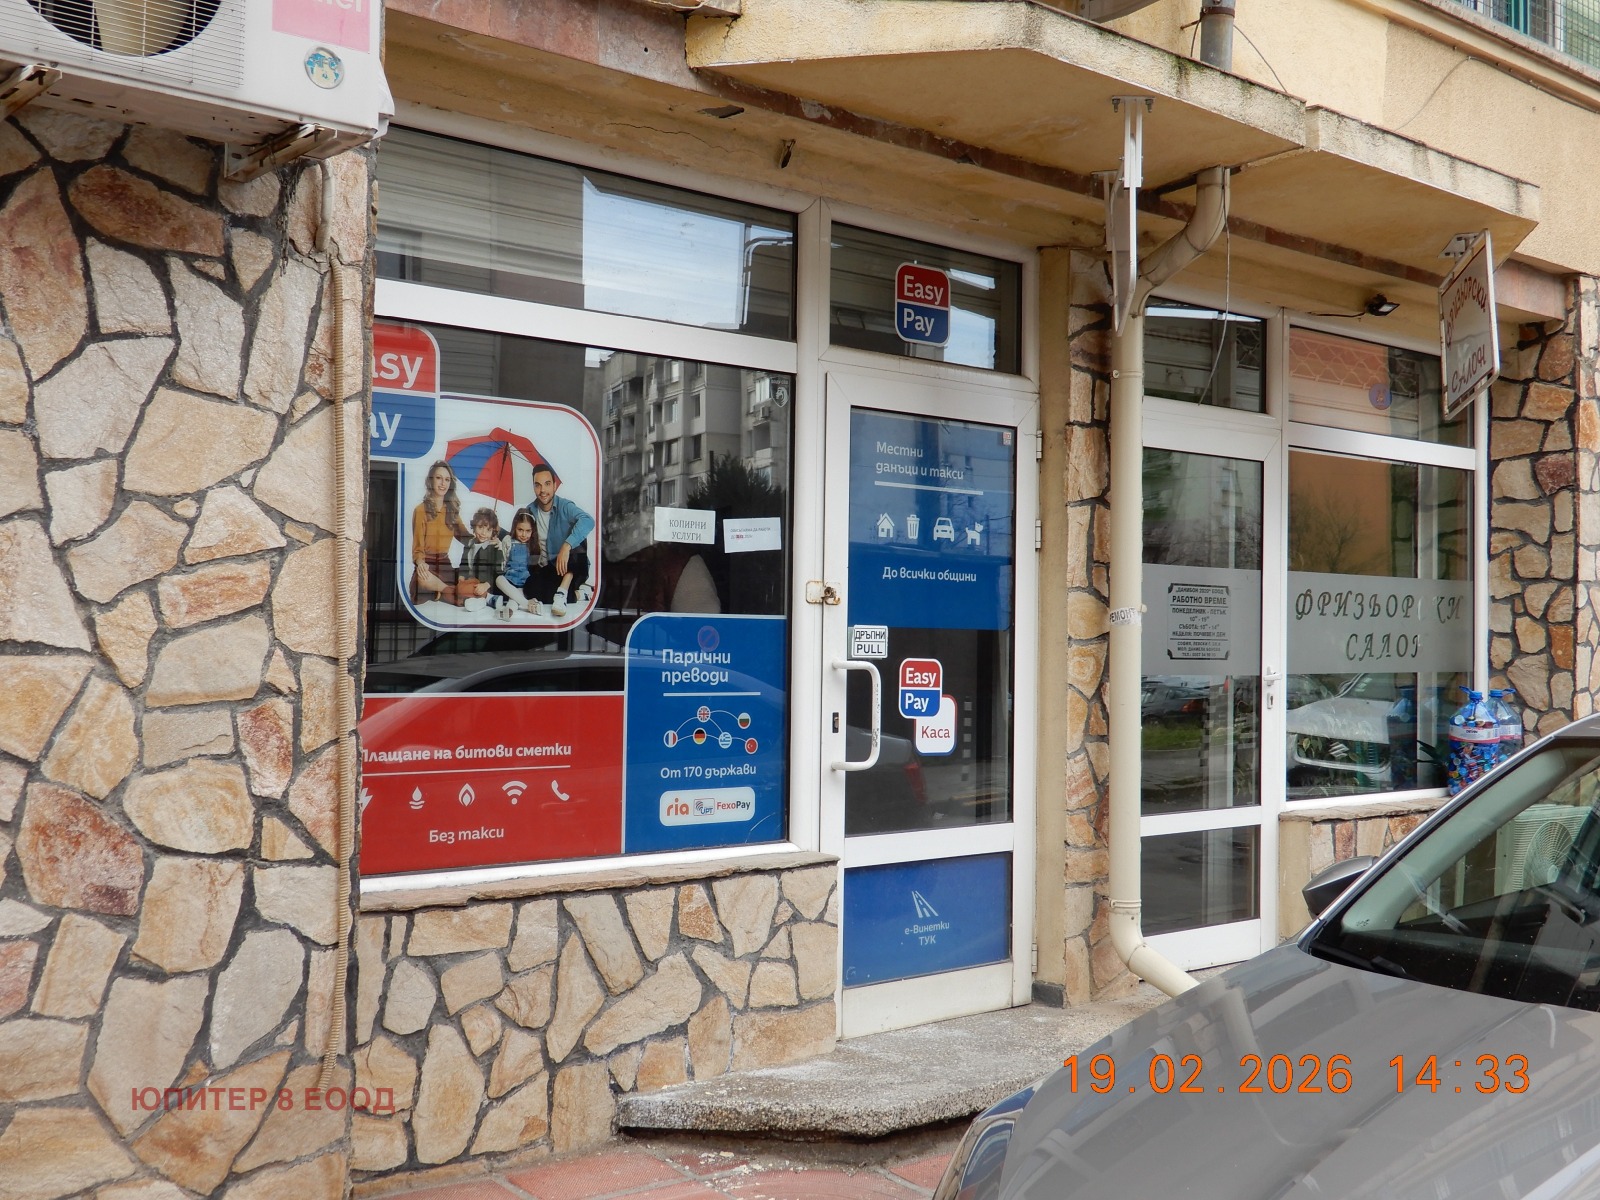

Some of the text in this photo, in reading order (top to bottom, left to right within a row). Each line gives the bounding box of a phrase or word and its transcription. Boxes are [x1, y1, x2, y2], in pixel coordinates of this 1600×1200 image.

[903, 274, 944, 305] Easy
[903, 308, 935, 337] Pay
[1452, 346, 1487, 392] САЛОН
[876, 441, 924, 458] Местни
[876, 462, 964, 480] данъци и такси
[669, 519, 707, 530] КОПИРНИ
[672, 532, 702, 541] УСЛУГИ
[882, 566, 977, 582] До всички общини
[1172, 595, 1227, 605] РАБОТНО ВРЕМЕ
[855, 630, 886, 640] ДРЪПНИ
[661, 648, 731, 667] Парични
[856, 644, 883, 654] PULL
[661, 667, 729, 685] преводи
[905, 667, 937, 687] Easy
[905, 692, 929, 712] Pay
[921, 726, 951, 738] Каса
[433, 748, 453, 760] на
[455, 744, 513, 759] битови
[516, 742, 572, 758] сметки
[660, 763, 757, 779] От 170 държави
[667, 797, 690, 816] ria
[716, 800, 751, 811] FexoPay
[429, 826, 505, 843] Без такси
[904, 920, 950, 935] е-Винетки
[918, 934, 937, 946] ТУК
